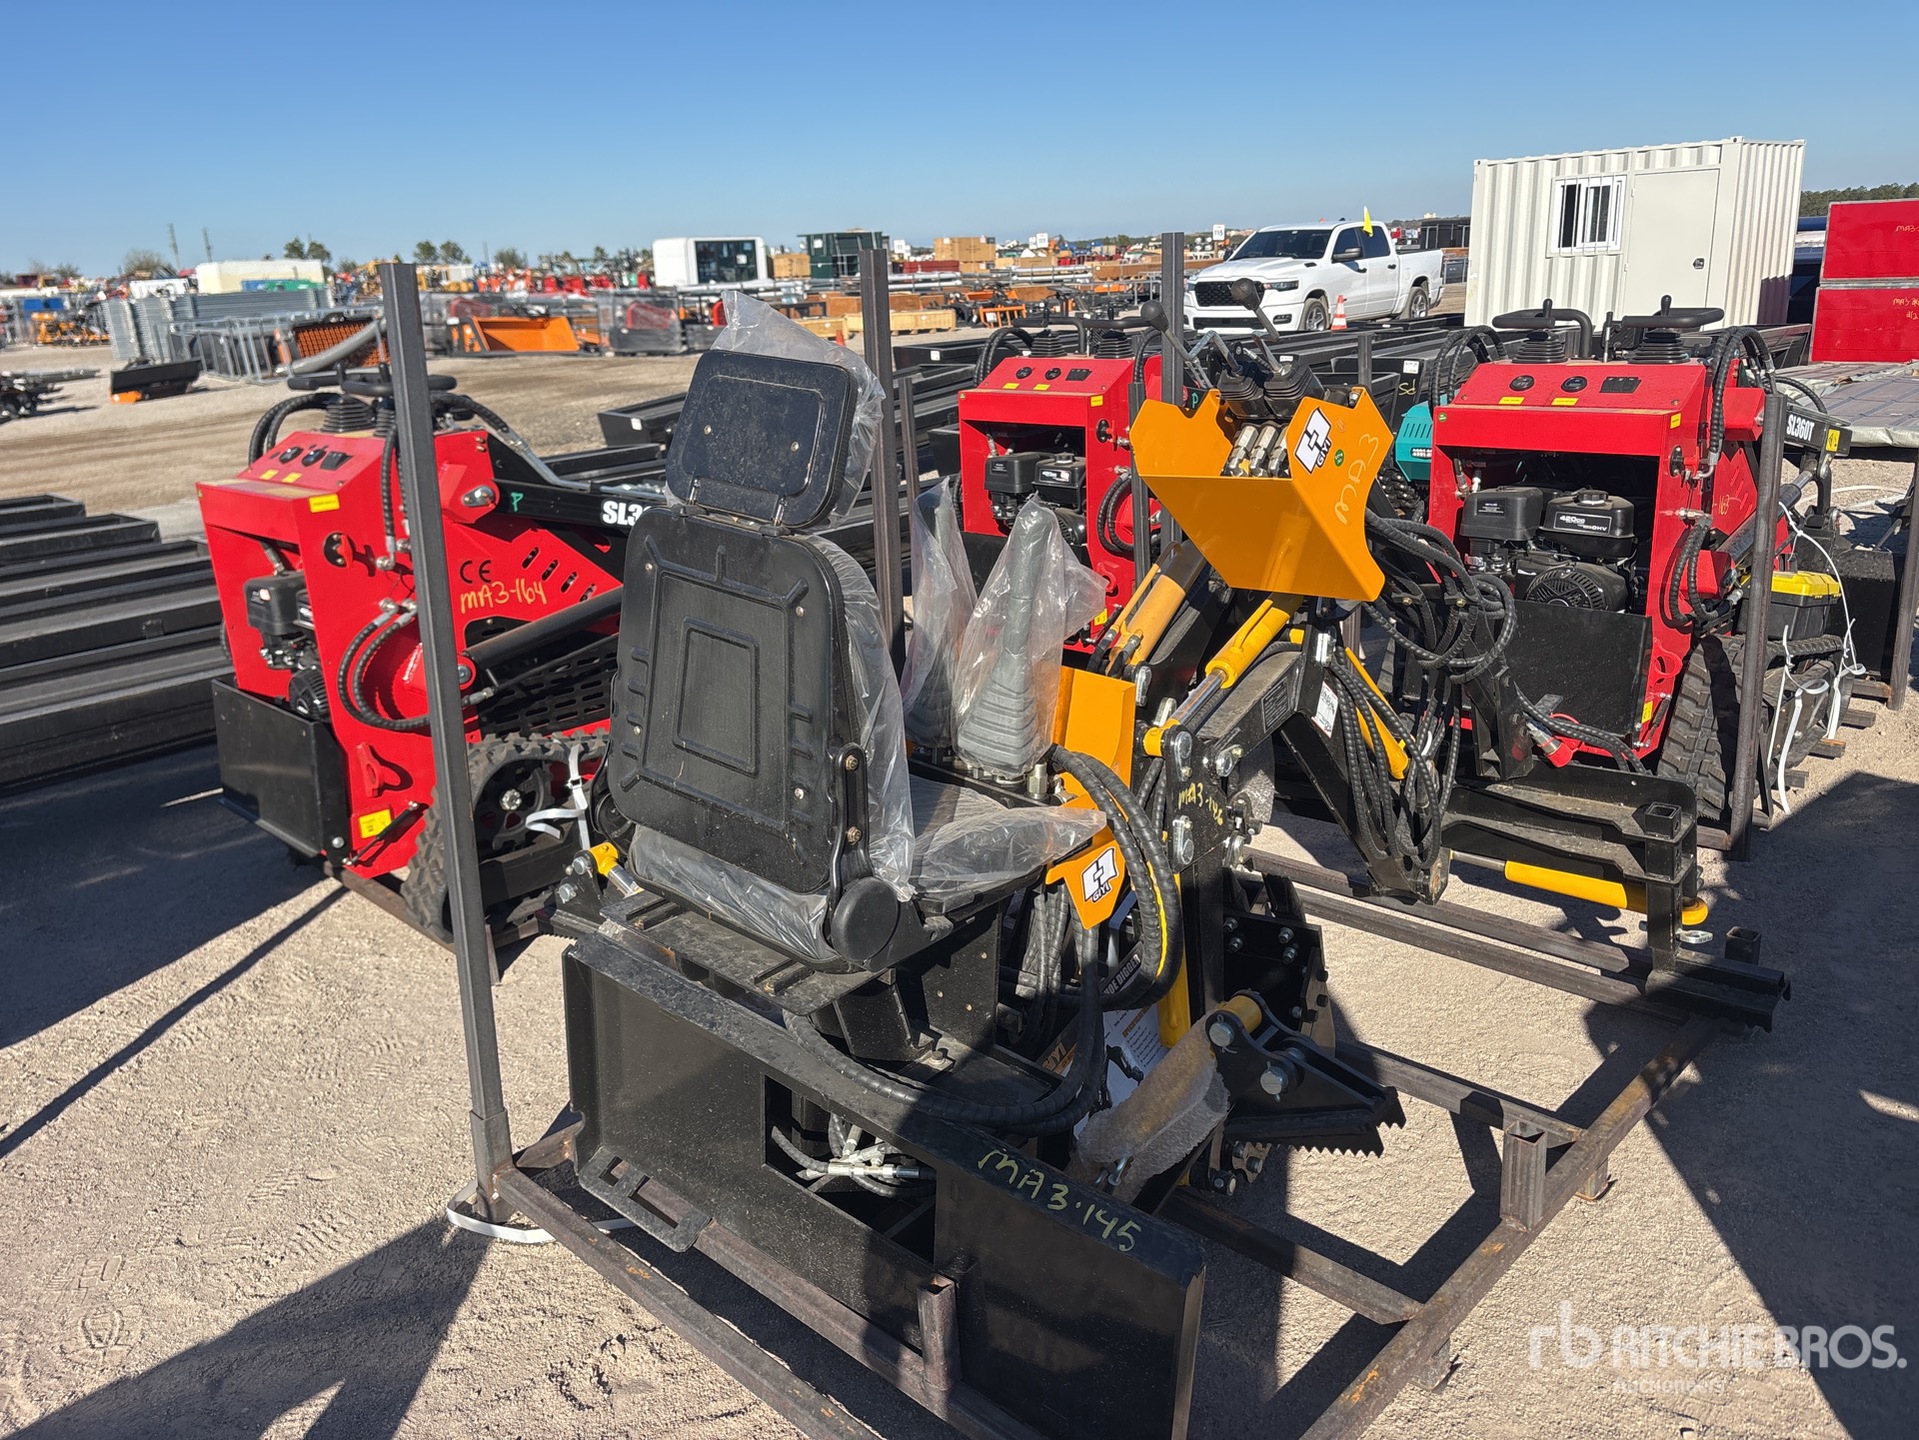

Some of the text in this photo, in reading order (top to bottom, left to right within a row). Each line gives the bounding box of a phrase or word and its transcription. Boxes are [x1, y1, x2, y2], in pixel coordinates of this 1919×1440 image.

[1786, 413, 1815, 442] SL360T
[1316, 439, 1331, 467] GIYI
[602, 500, 651, 527] SL3
[460, 559, 492, 584] CE
[1092, 884, 1111, 902] GIYI
[1115, 953, 1141, 985] DIGGER
